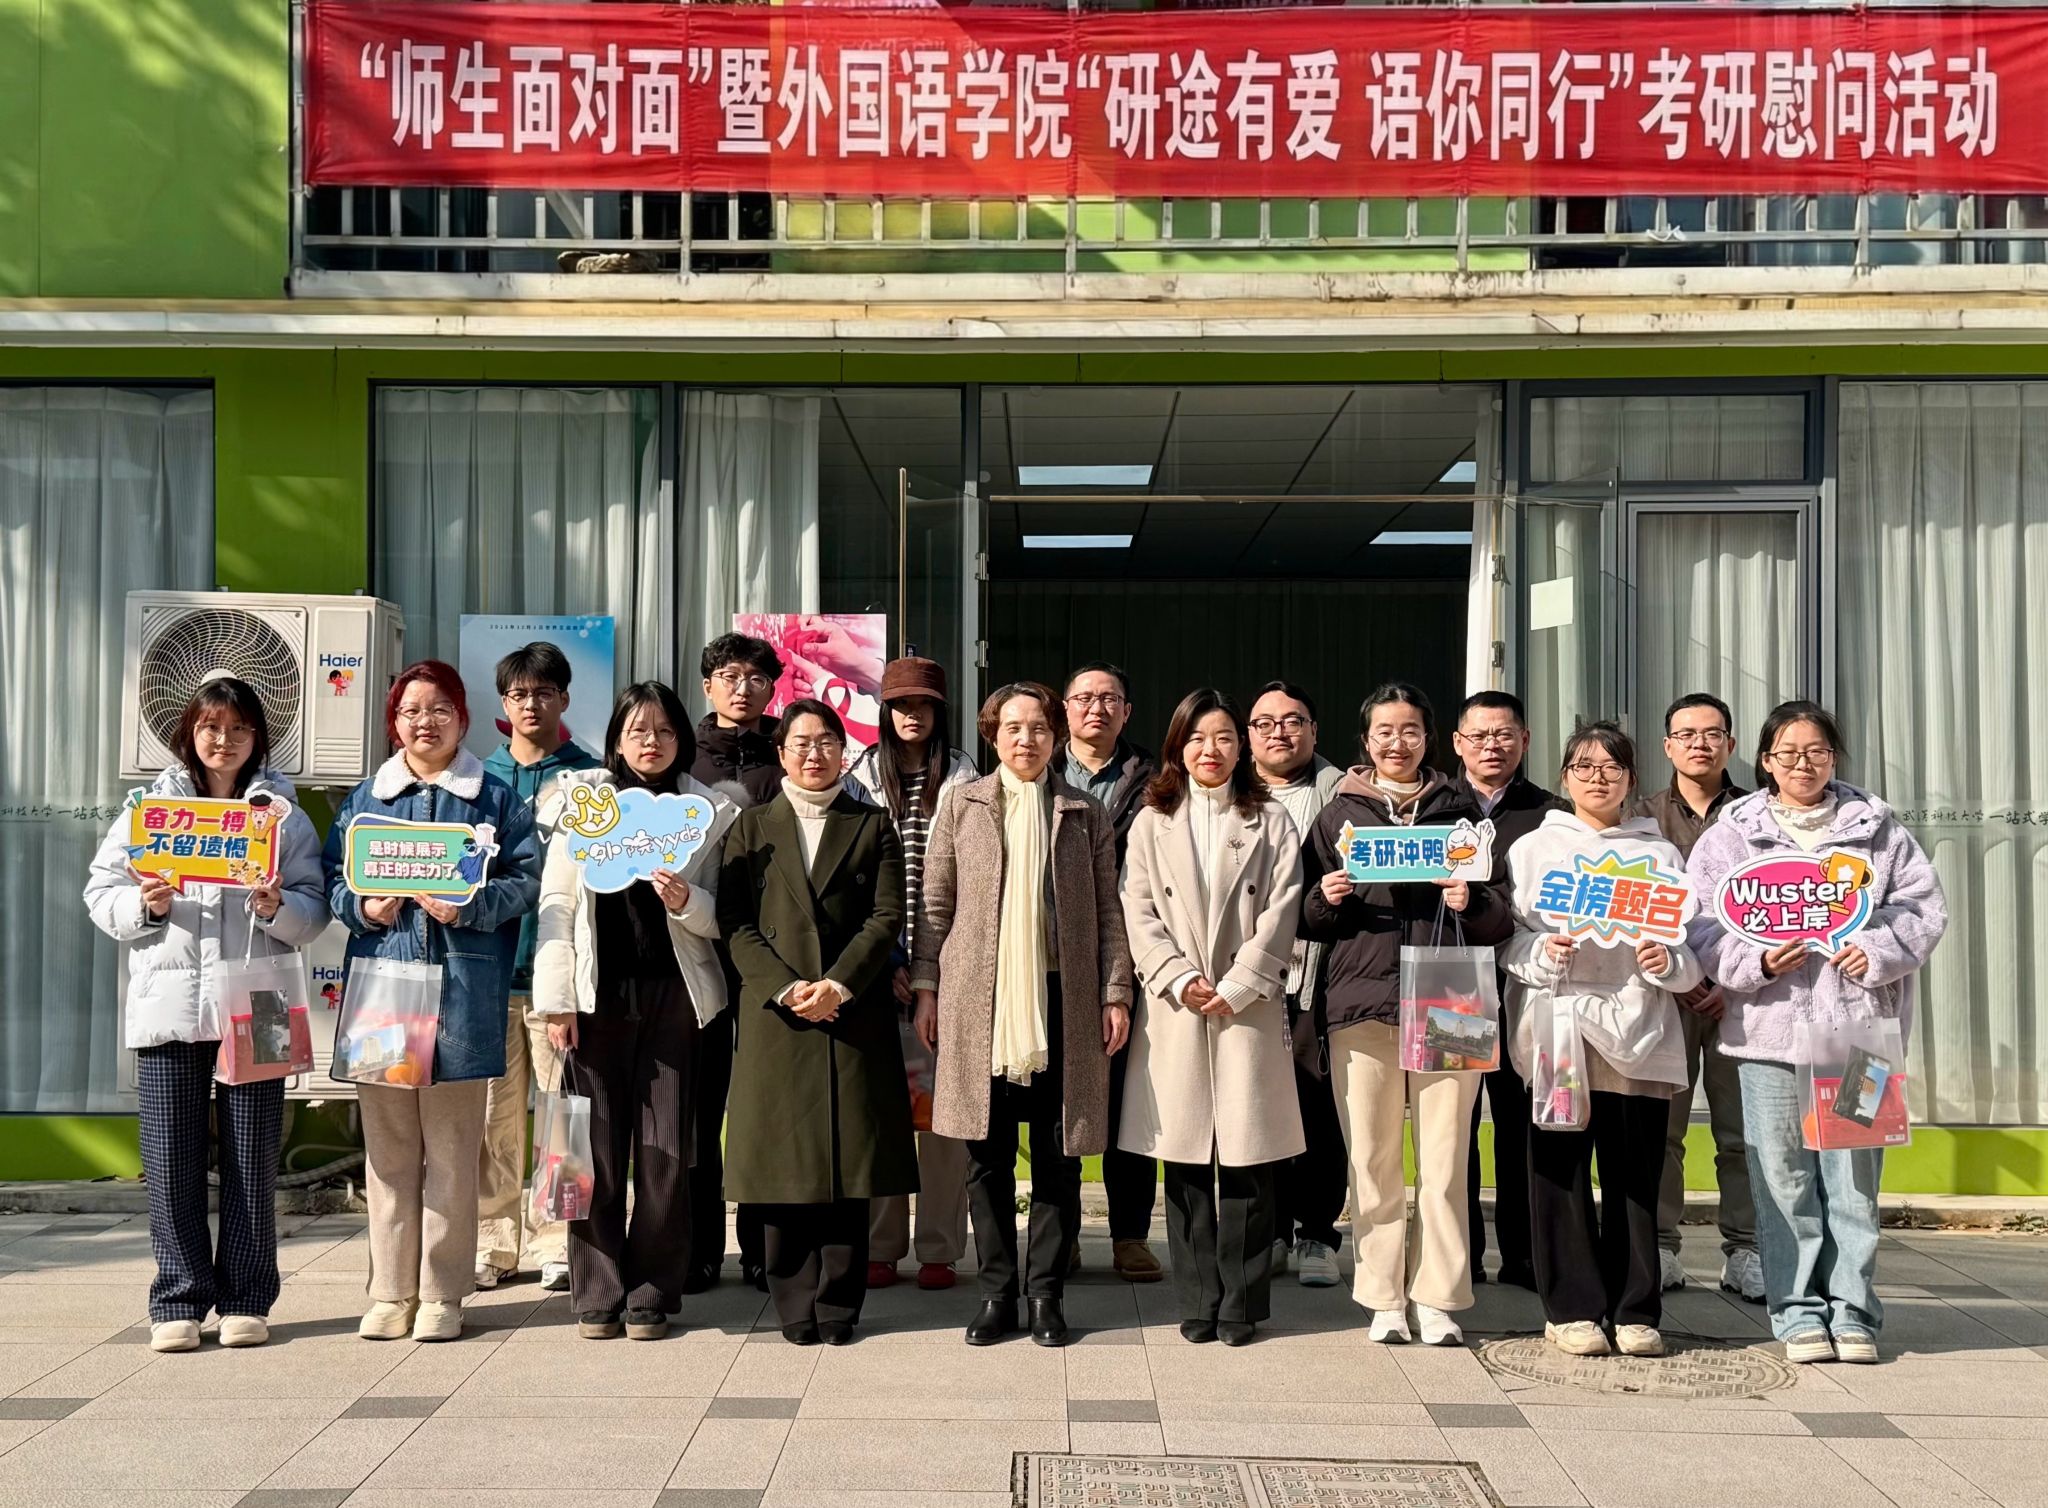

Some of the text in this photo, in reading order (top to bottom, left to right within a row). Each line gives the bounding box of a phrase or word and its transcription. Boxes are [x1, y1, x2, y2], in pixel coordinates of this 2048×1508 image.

[360, 40, 1999, 162] “师生面对面”暨外国语学院“研途有爱 语你同行”考研慰问活动
[319, 653, 363, 667] Haier
[58, 804, 119, 821] 一站式学
[144, 806, 247, 832] 奋力一搏
[146, 832, 249, 859] 不留遗憾
[368, 840, 448, 858] 是时候展示
[1350, 837, 1446, 868] 考研冲鸭
[363, 861, 458, 880] 真正的实力了
[1535, 870, 1688, 928] 金榜题名
[1729, 876, 1853, 906] Wuster
[1741, 903, 1831, 933] 必上岸
